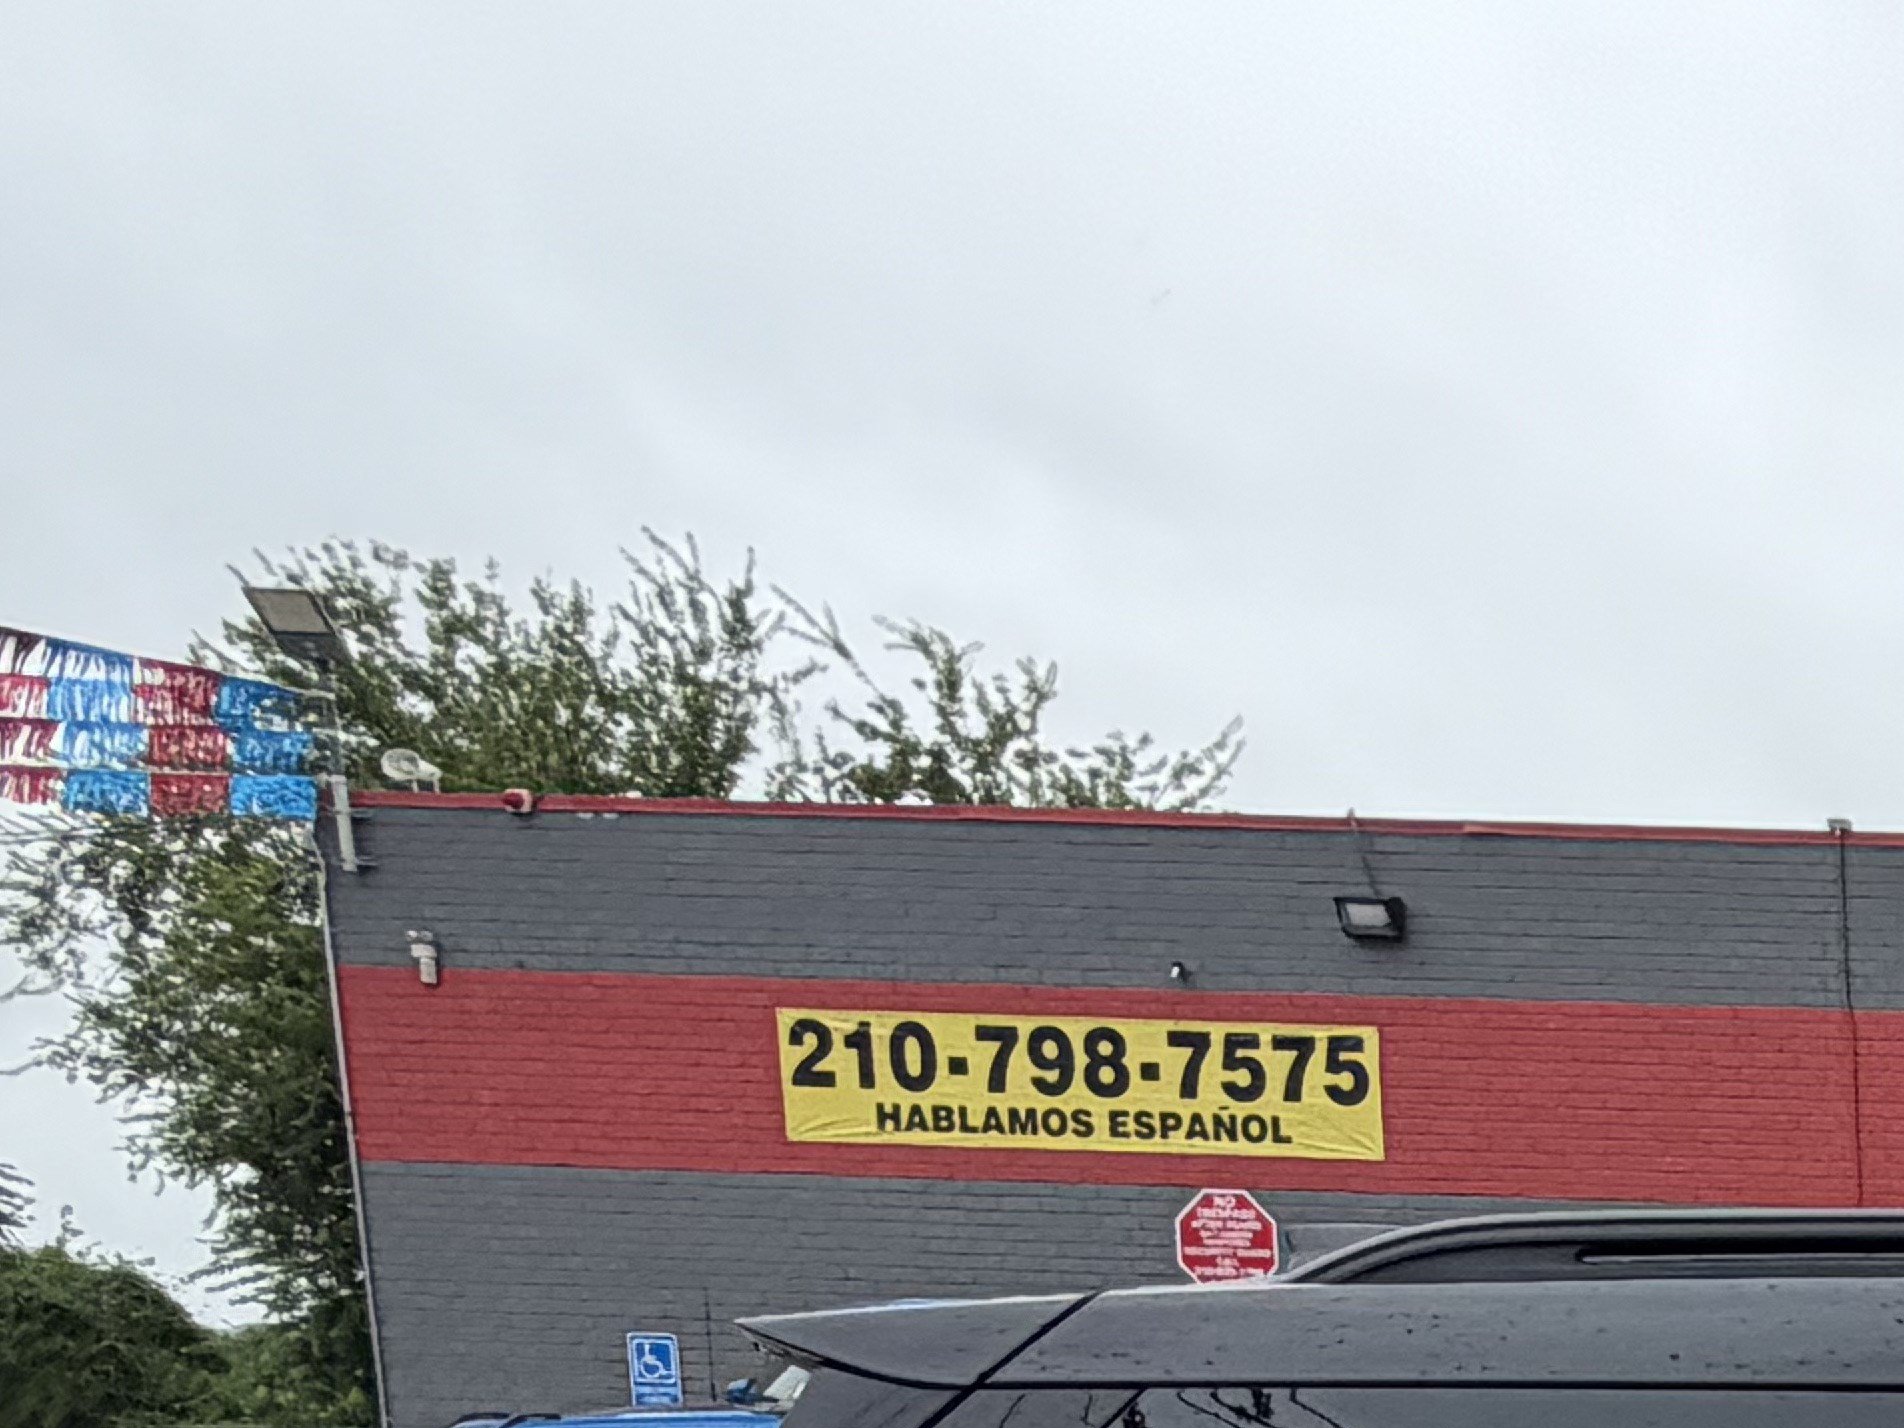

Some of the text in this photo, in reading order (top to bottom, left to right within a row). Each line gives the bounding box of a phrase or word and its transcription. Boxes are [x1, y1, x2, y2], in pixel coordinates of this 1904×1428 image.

[787, 1018, 1370, 1106] 210-798-7575
[876, 1102, 1293, 1145] HABLAMOS ESPAÑOL
